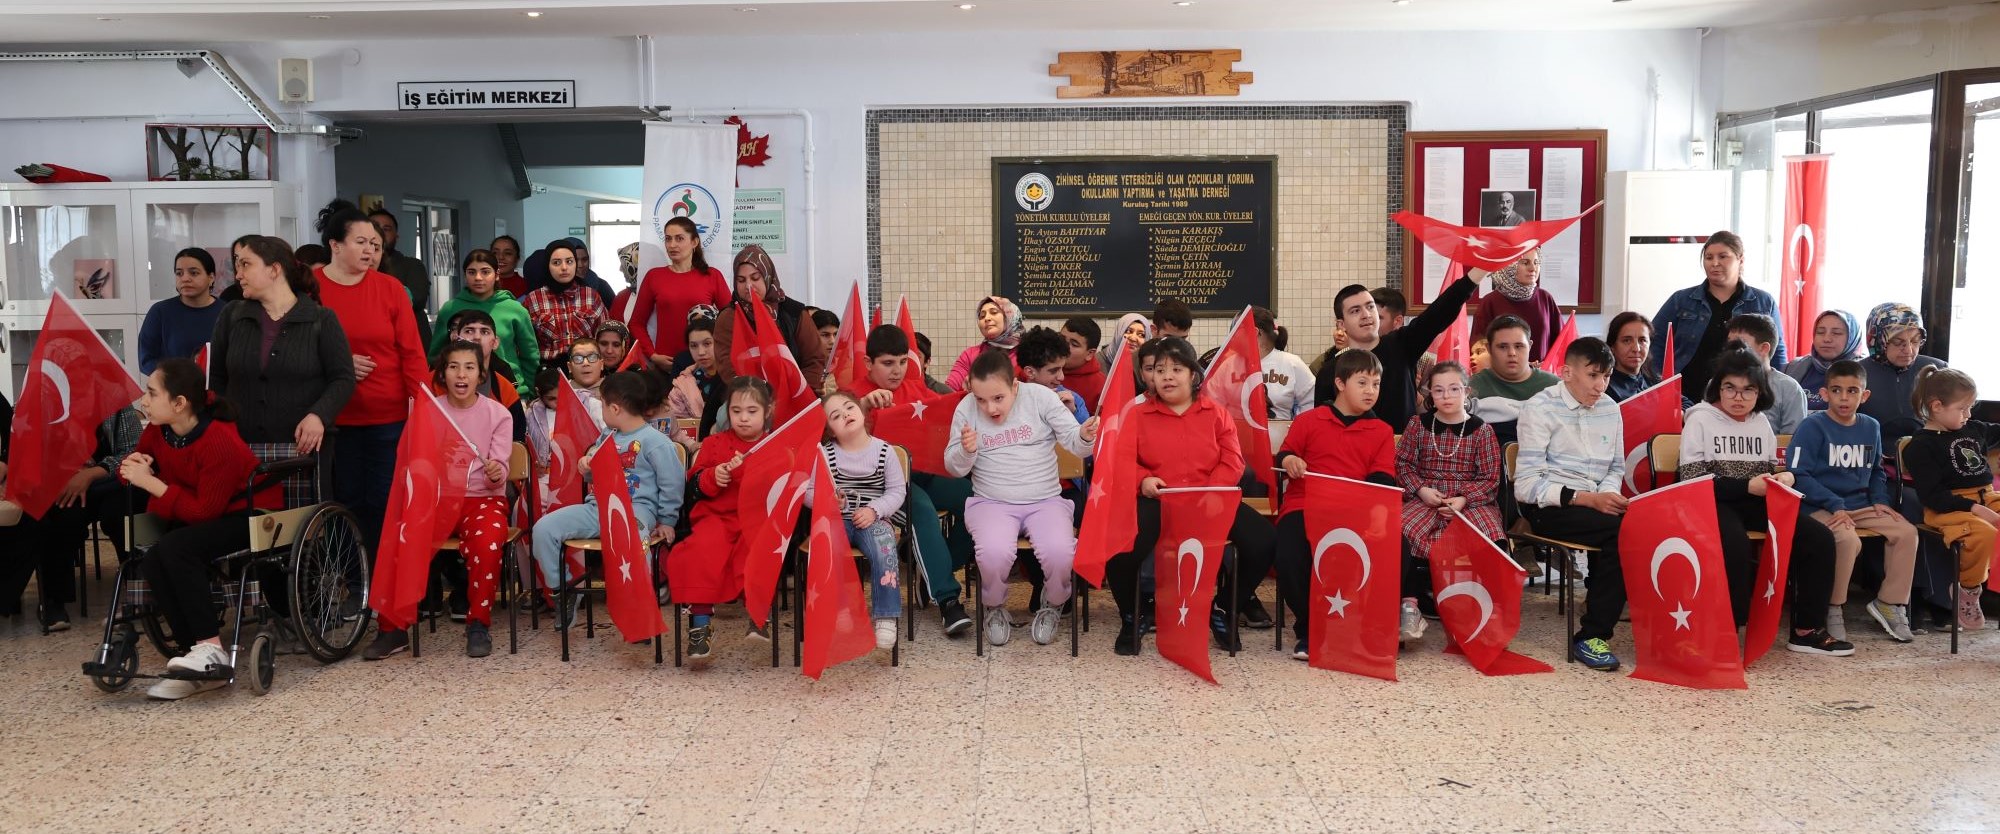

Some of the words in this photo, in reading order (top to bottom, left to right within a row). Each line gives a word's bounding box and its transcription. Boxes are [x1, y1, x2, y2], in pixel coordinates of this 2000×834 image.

[404, 89, 421, 108] İŞ
[426, 88, 486, 105] EĞİTİM
[491, 88, 567, 104] MERKEZİ
[1056, 172, 1085, 186] ZİHİNSEL
[1088, 172, 1118, 186] ÖĞRENME
[1121, 172, 1164, 186] YETERSİZLİĞİ
[1167, 174, 1184, 184] OLAN
[1187, 174, 1224, 187] ÇOCUKLARI
[1227, 174, 1254, 184] KORUMA
[1081, 188, 1119, 199] OKULLARINI
[1122, 187, 1154, 198] YAPTIRMA
[1158, 190, 1166, 198] ve
[1169, 187, 1198, 200] YAŞATMA
[1202, 185, 1230, 198] DERNEĞİ
[1151, 200, 1170, 208] Tarihi
[1015, 212, 1049, 222] YÖNETİM
[1050, 213, 1079, 222] KURULU
[1080, 212, 1110, 221] ÜYELERİ
[1139, 212, 1162, 220] EMEĞİ
[1163, 212, 1186, 222] GEÇEN
[1188, 210, 1203, 220] YÖN.
[1206, 212, 1222, 220] KUR.
[1224, 210, 1253, 220] ÜYELERİ
[1024, 228, 1034, 236] Dr.
[1036, 228, 1058, 237] Ayten
[1060, 227, 1106, 236] BAHTİYAR
[1154, 227, 1180, 235] Nurten
[1182, 226, 1224, 236] KARAKIŞ
[1045, 236, 1076, 244] ÖZSOY
[1154, 236, 1180, 244] Nilgün
[1051, 262, 1082, 271] TOKER
[1182, 262, 1222, 270] BAYRAM
[1024, 280, 1047, 288] Zerrin
[1052, 288, 1076, 297] ÖZEL
[1154, 288, 1178, 296] Nalan
[1180, 287, 1218, 296] KAYNAK
[1024, 297, 1048, 305] Nazan
